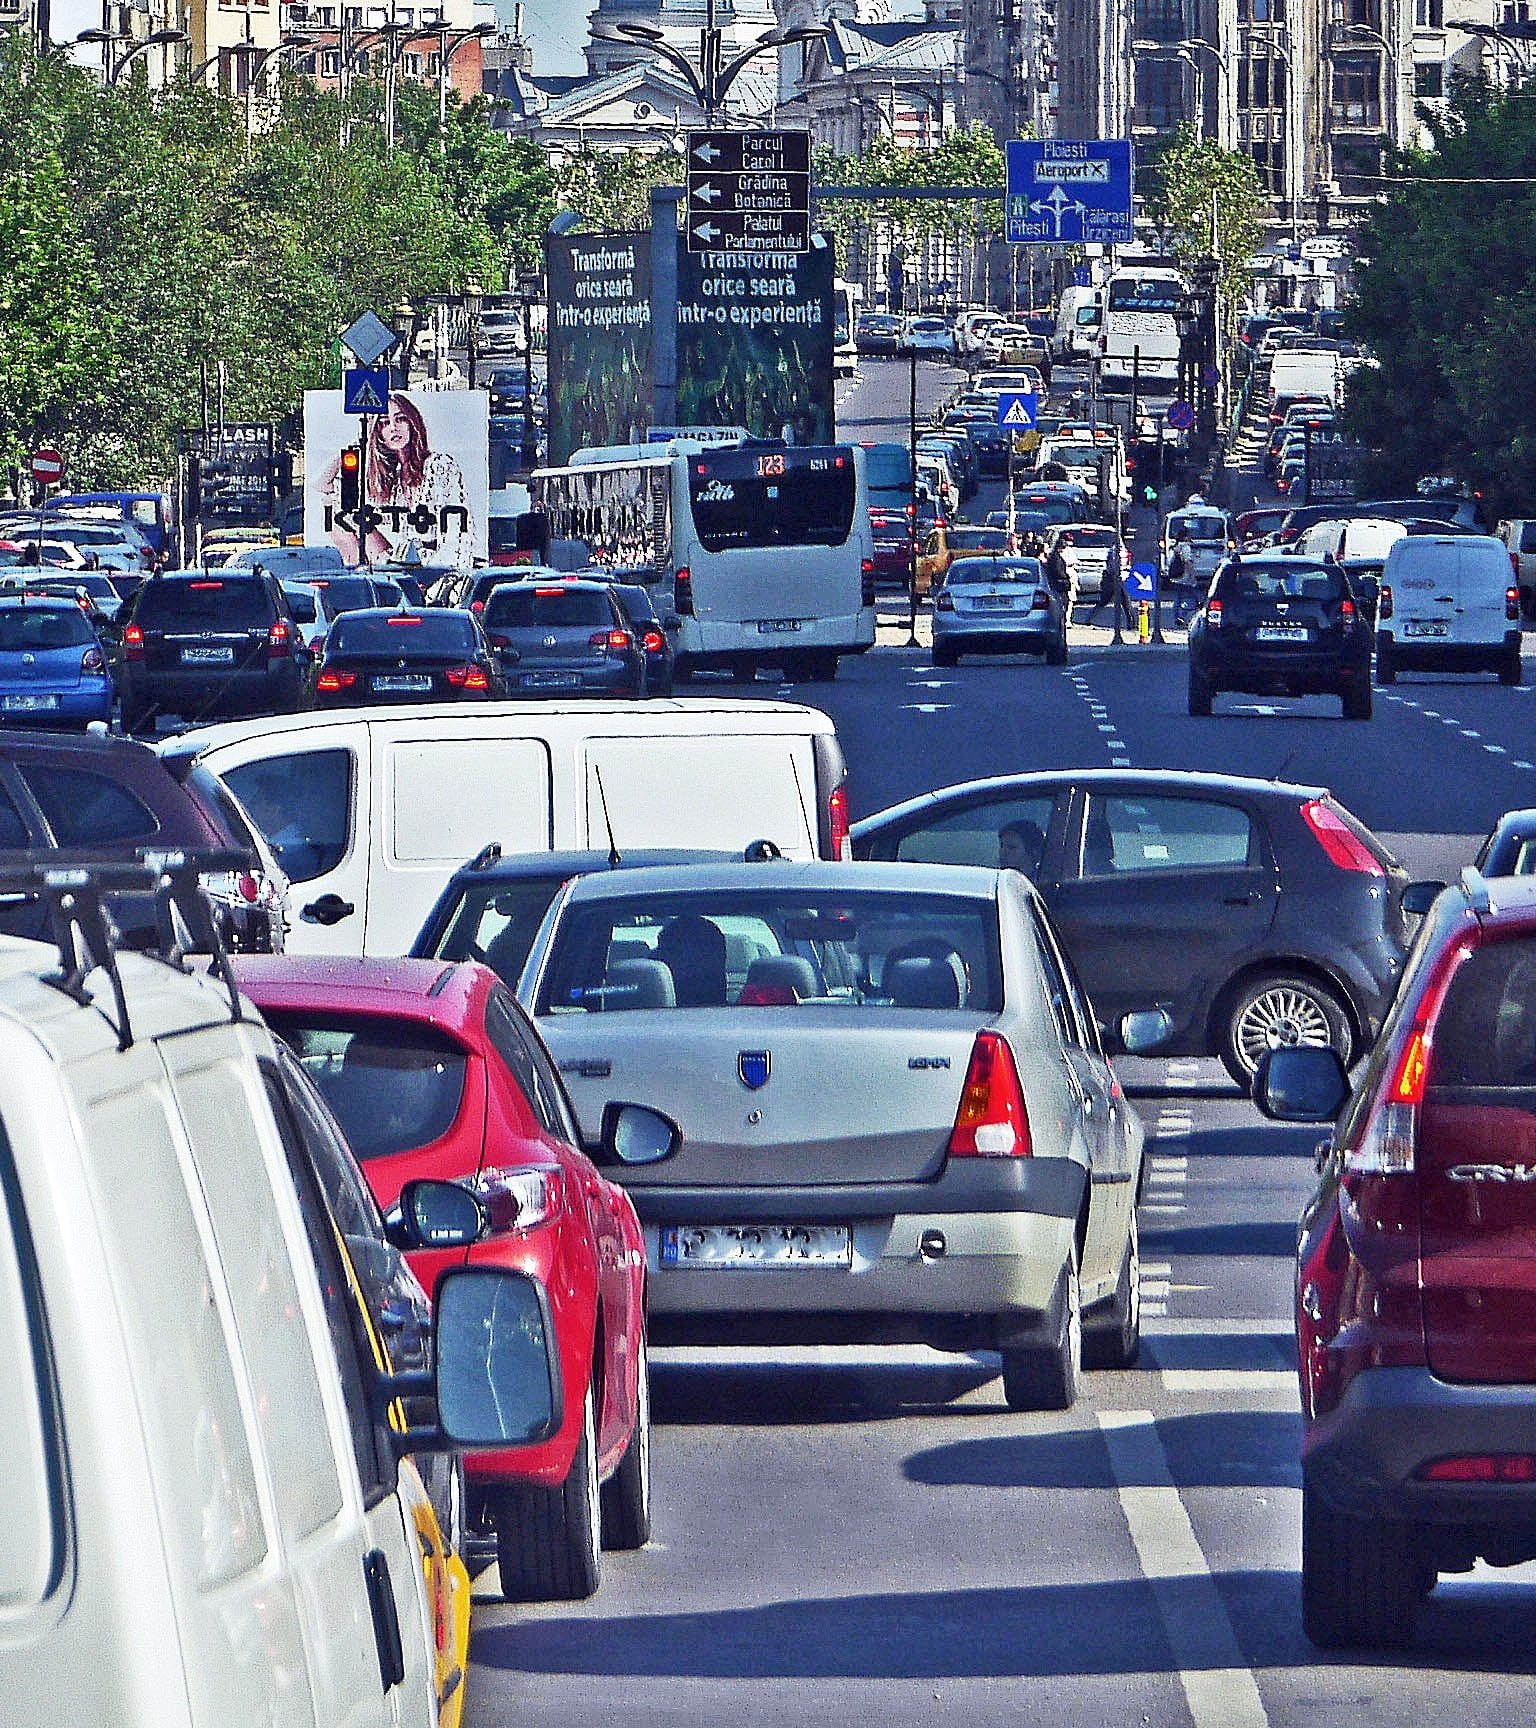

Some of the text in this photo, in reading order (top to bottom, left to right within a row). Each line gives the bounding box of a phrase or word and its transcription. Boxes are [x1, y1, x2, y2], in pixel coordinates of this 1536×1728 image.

[742, 135, 783, 151] Parcul
[742, 153, 775, 170] Carol
[1037, 162, 1089, 181] Aeroport
[738, 174, 788, 191] Grădina
[734, 192, 792, 208] Botanică
[743, 214, 782, 231] Palatul
[725, 232, 802, 249] Parlamentului
[571, 246, 635, 271] Transformă
[575, 274, 633, 298] orice seară
[701, 272, 796, 297] orice seară
[555, 300, 651, 329] într-o experiență
[677, 299, 821, 329] într-o experiență
[757, 454, 785, 476] 123
